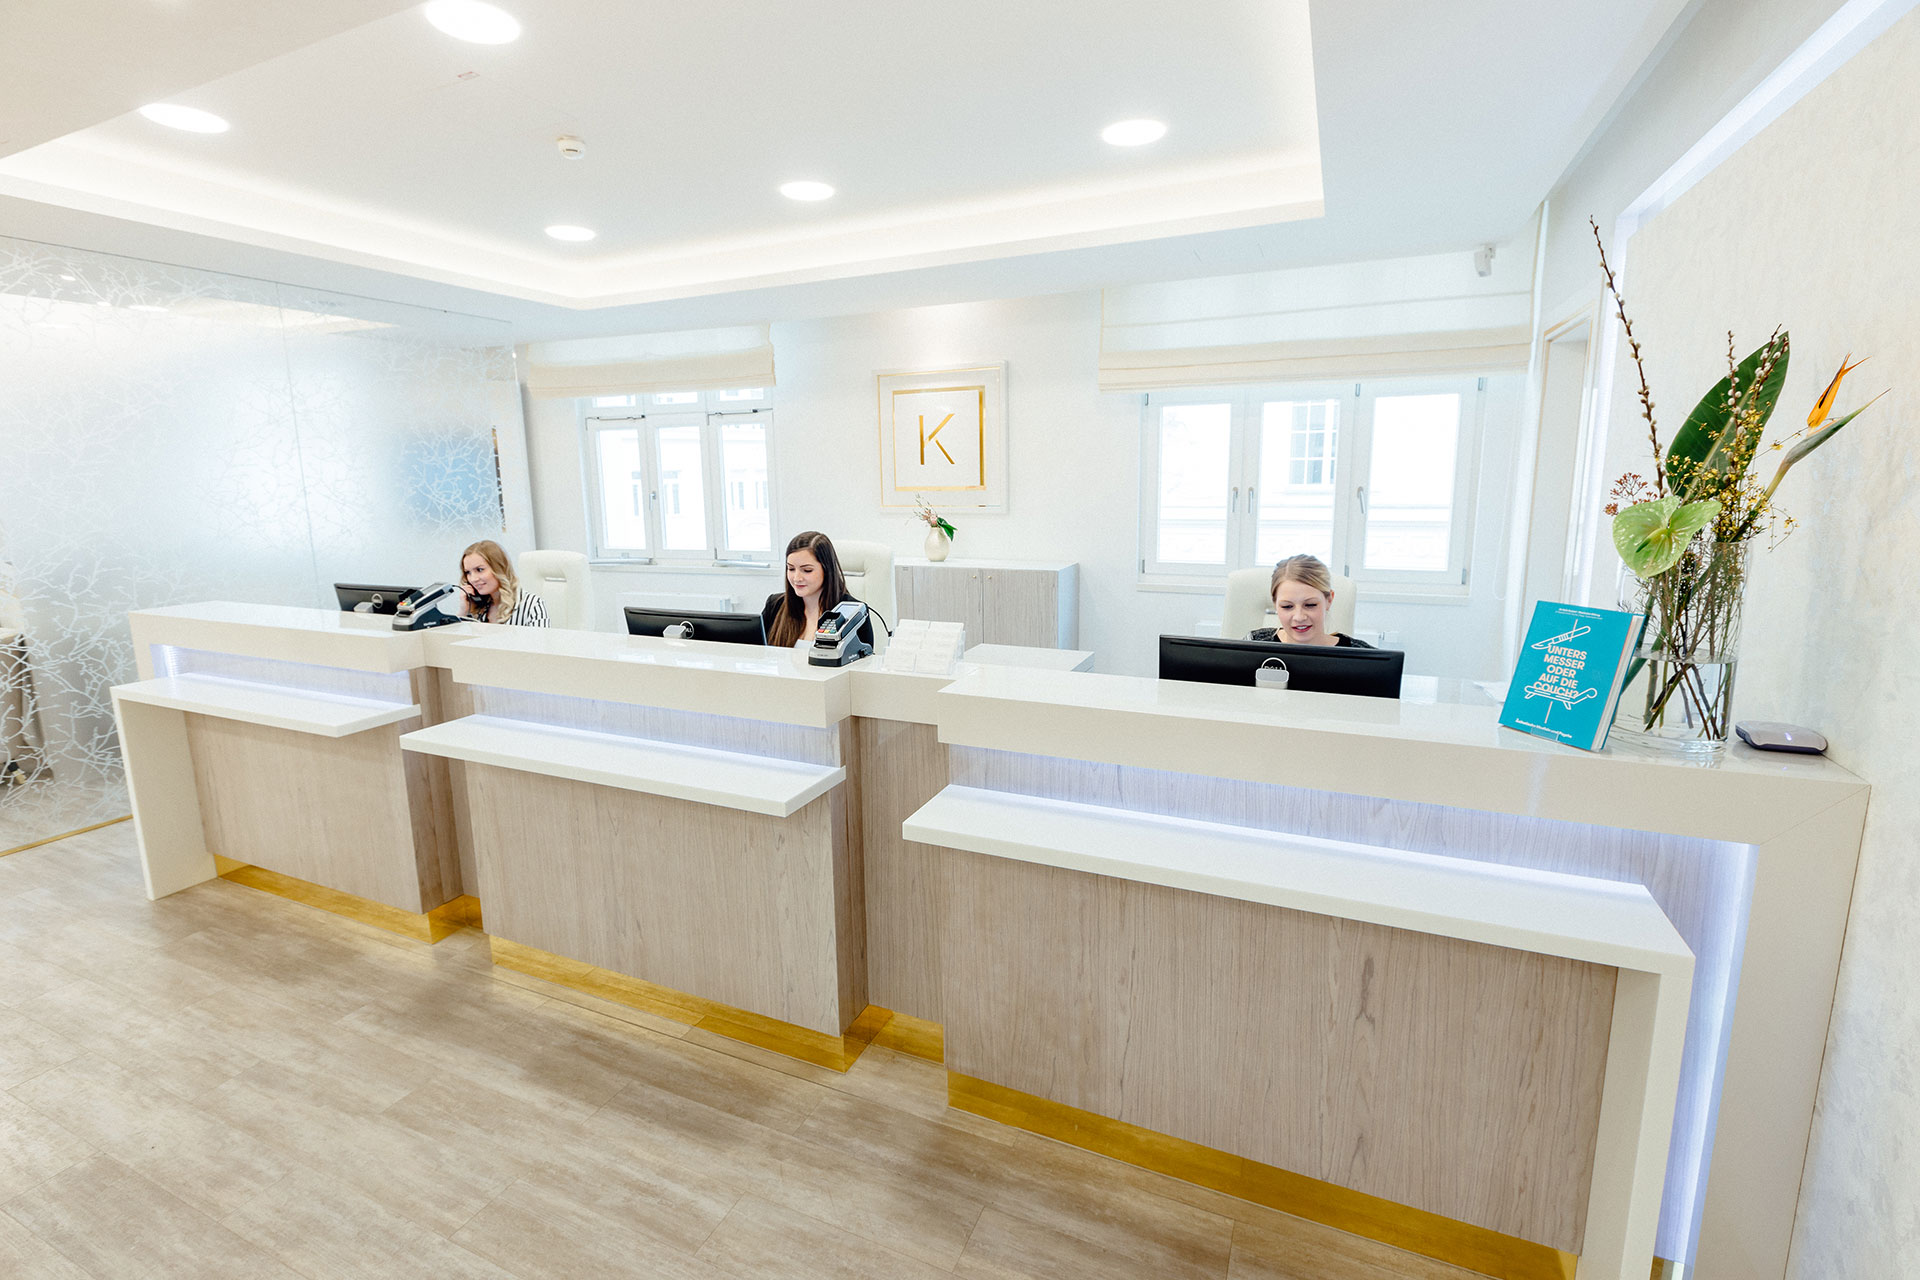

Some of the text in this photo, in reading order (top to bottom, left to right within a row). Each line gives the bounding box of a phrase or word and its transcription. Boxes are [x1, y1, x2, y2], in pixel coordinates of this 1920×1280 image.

[918, 413, 956, 466] K
[1547, 645, 1587, 660] UNTERS
[1543, 654, 1585, 670] MESSER
[1546, 664, 1576, 678] ODER
[1538, 673, 1579, 689] AUF DIE
[1533, 681, 1579, 699] COUCH?
